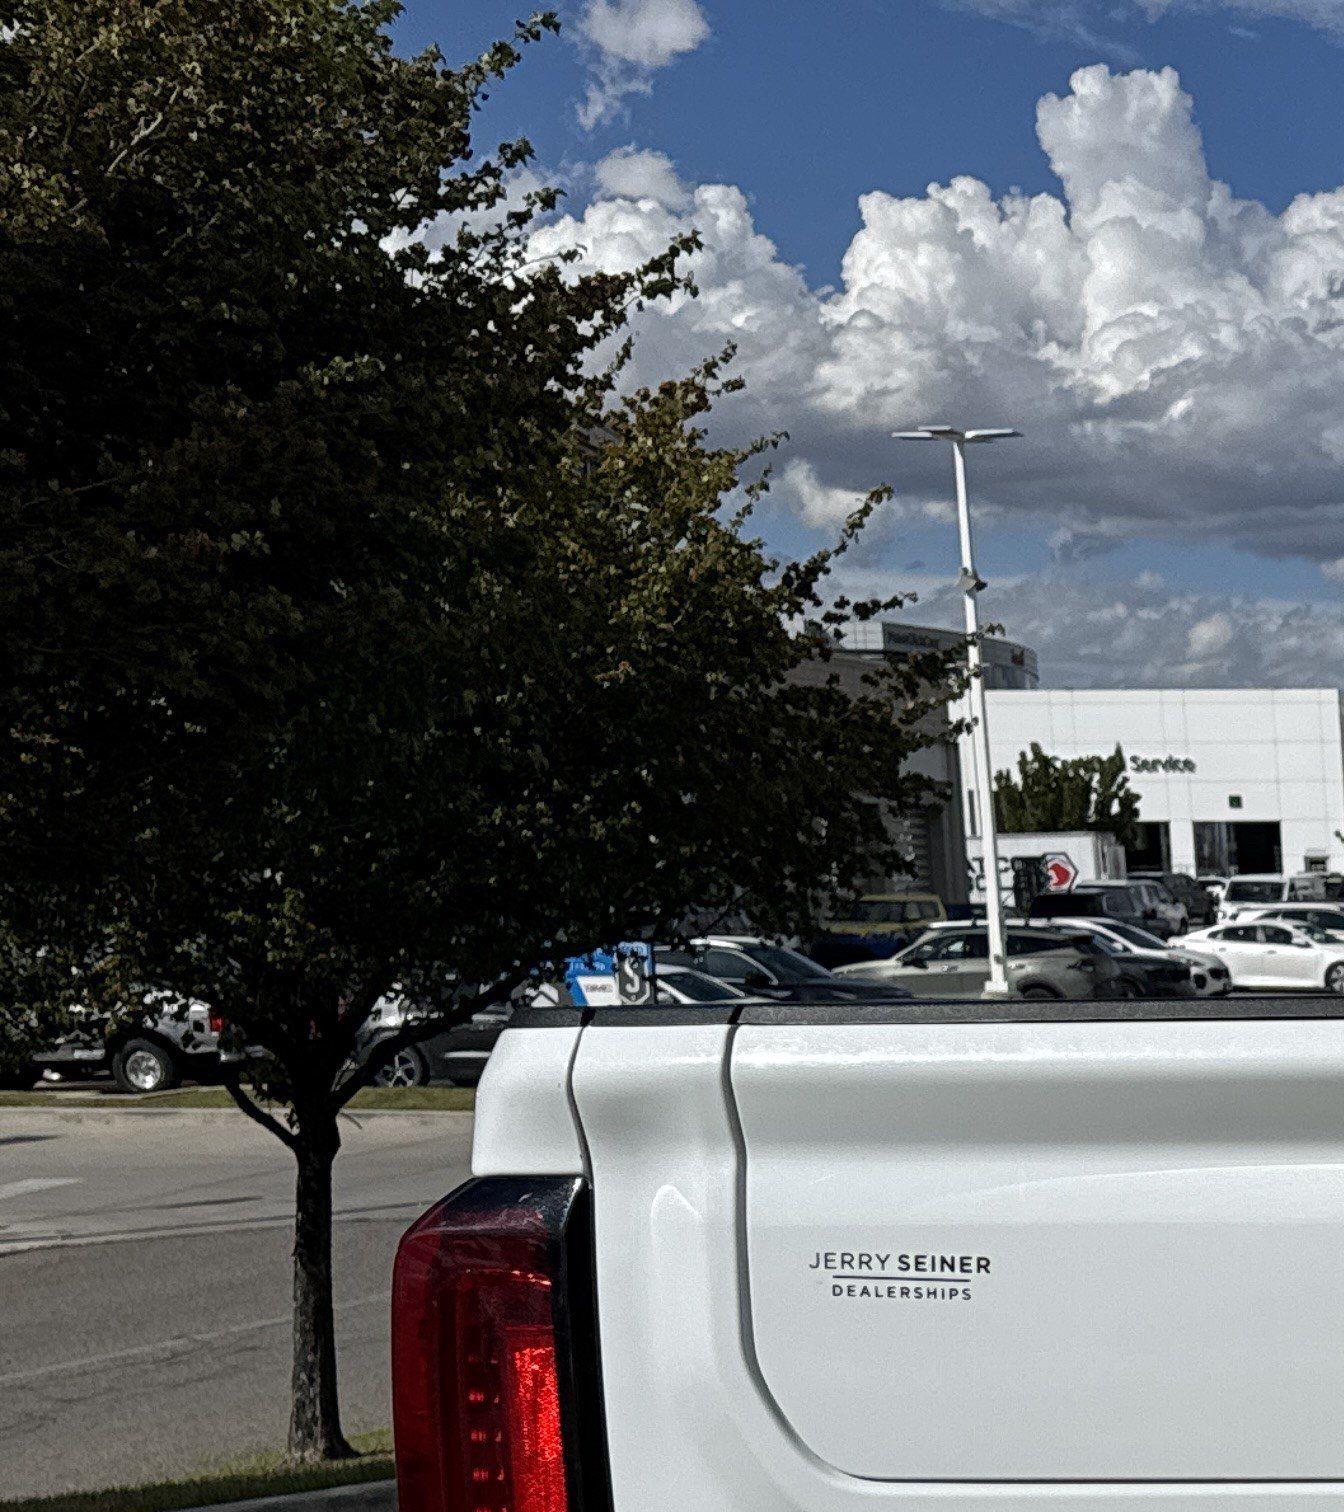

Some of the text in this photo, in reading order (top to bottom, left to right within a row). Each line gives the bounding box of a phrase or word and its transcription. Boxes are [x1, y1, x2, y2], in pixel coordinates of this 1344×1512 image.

[1130, 754, 1196, 773] Service
[809, 1252, 991, 1273] JERRY SEINER
[832, 1284, 972, 1300] DEALERSHIPS
